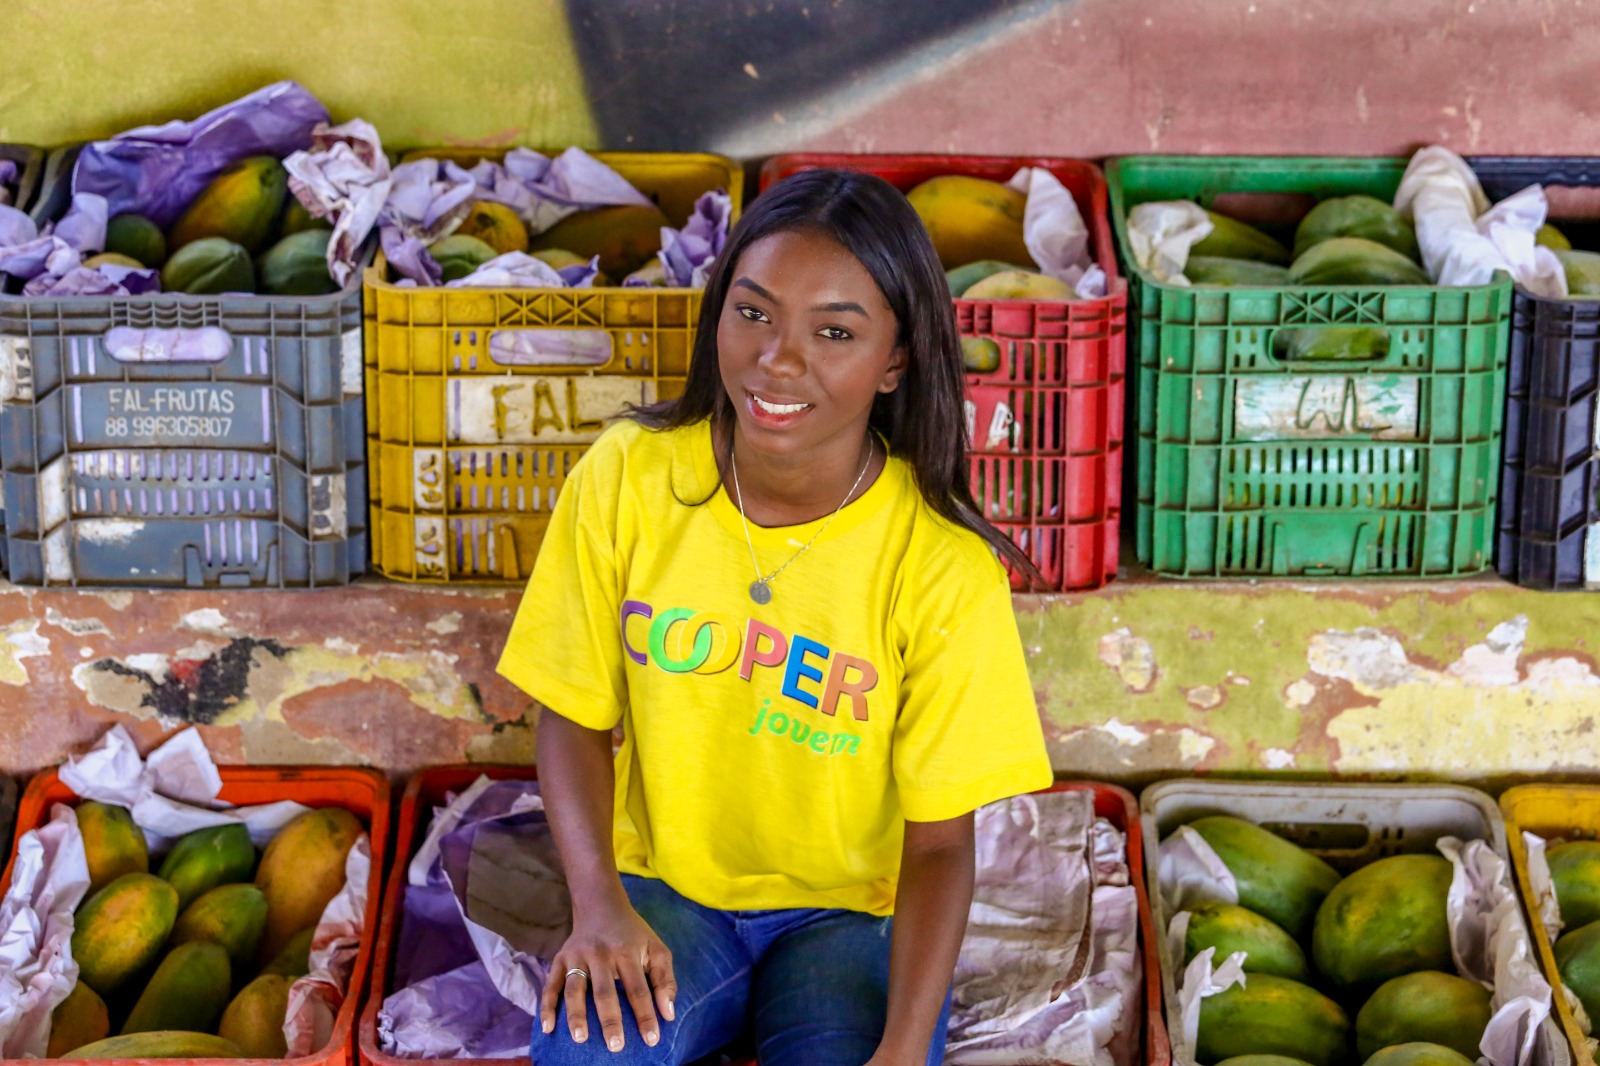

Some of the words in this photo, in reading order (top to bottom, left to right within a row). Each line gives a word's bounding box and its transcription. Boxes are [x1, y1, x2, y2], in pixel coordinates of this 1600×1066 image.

[109, 388, 235, 413] FAL-FRUTAS
[105, 416, 128, 437] 88
[132, 416, 232, 437] 996305807
[620, 599, 879, 722] COOPER
[748, 698, 862, 755] jovem
